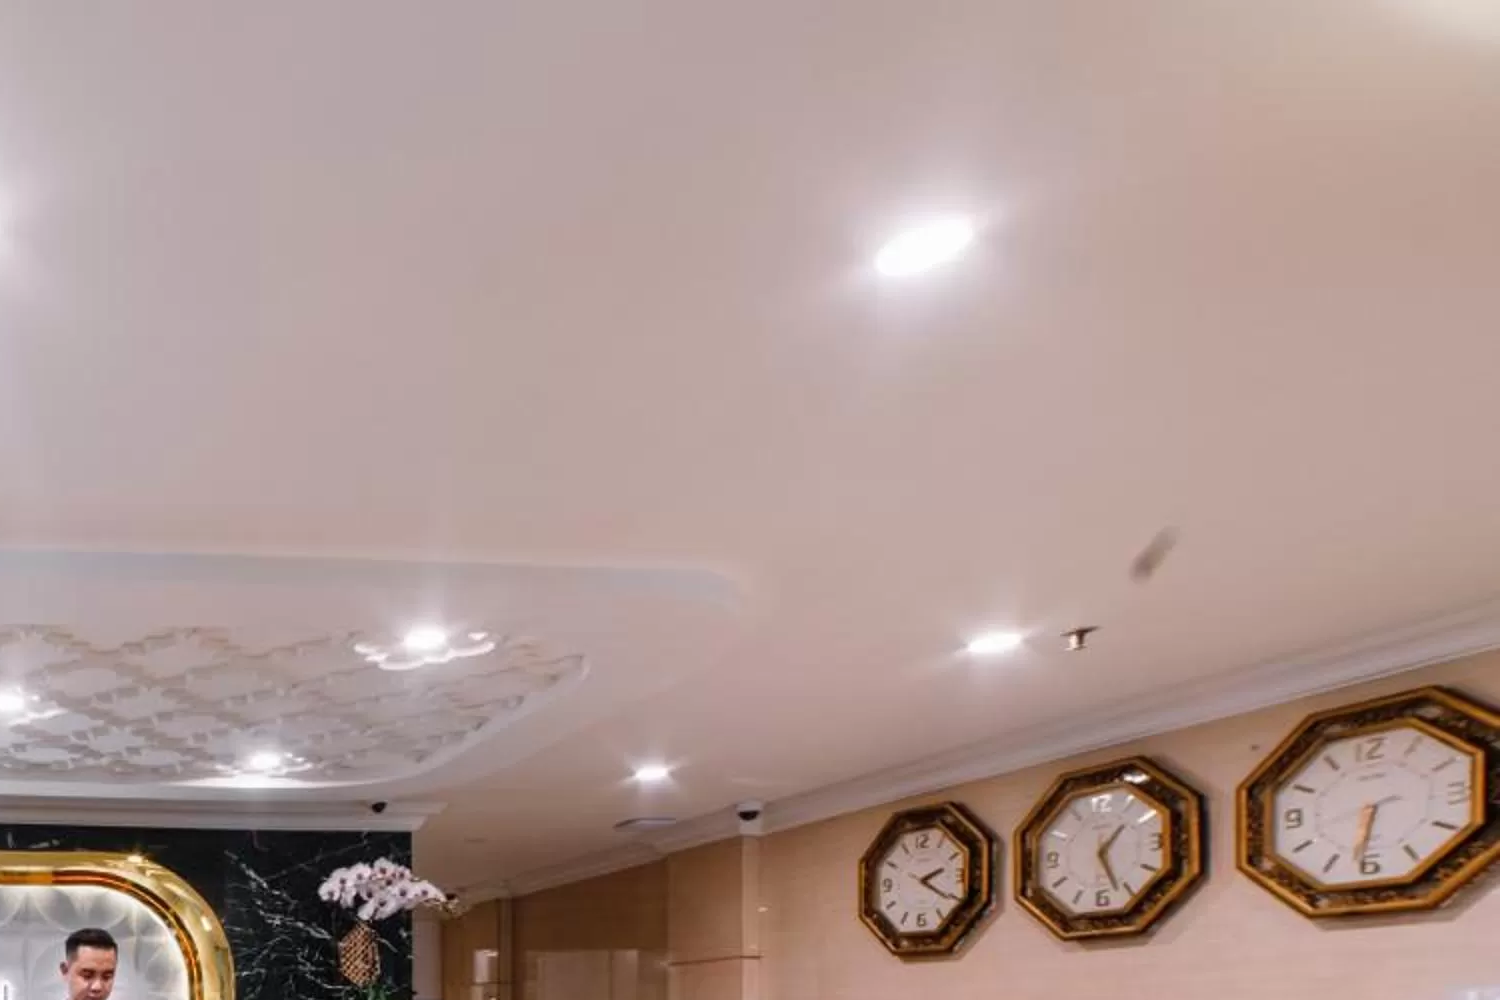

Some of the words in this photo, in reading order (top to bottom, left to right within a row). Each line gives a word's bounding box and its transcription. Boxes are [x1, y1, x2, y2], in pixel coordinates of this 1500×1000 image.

[1355, 735, 1388, 763] 12
[1090, 793, 1112, 813] 12
[1284, 808, 1304, 830] 9
[915, 832, 930, 849] 12
[1047, 851, 1060, 869] 9
[1359, 853, 1381, 875] 6
[883, 878, 894, 893] 9
[1095, 889, 1110, 907] 6
[916, 912, 928, 928] 6
